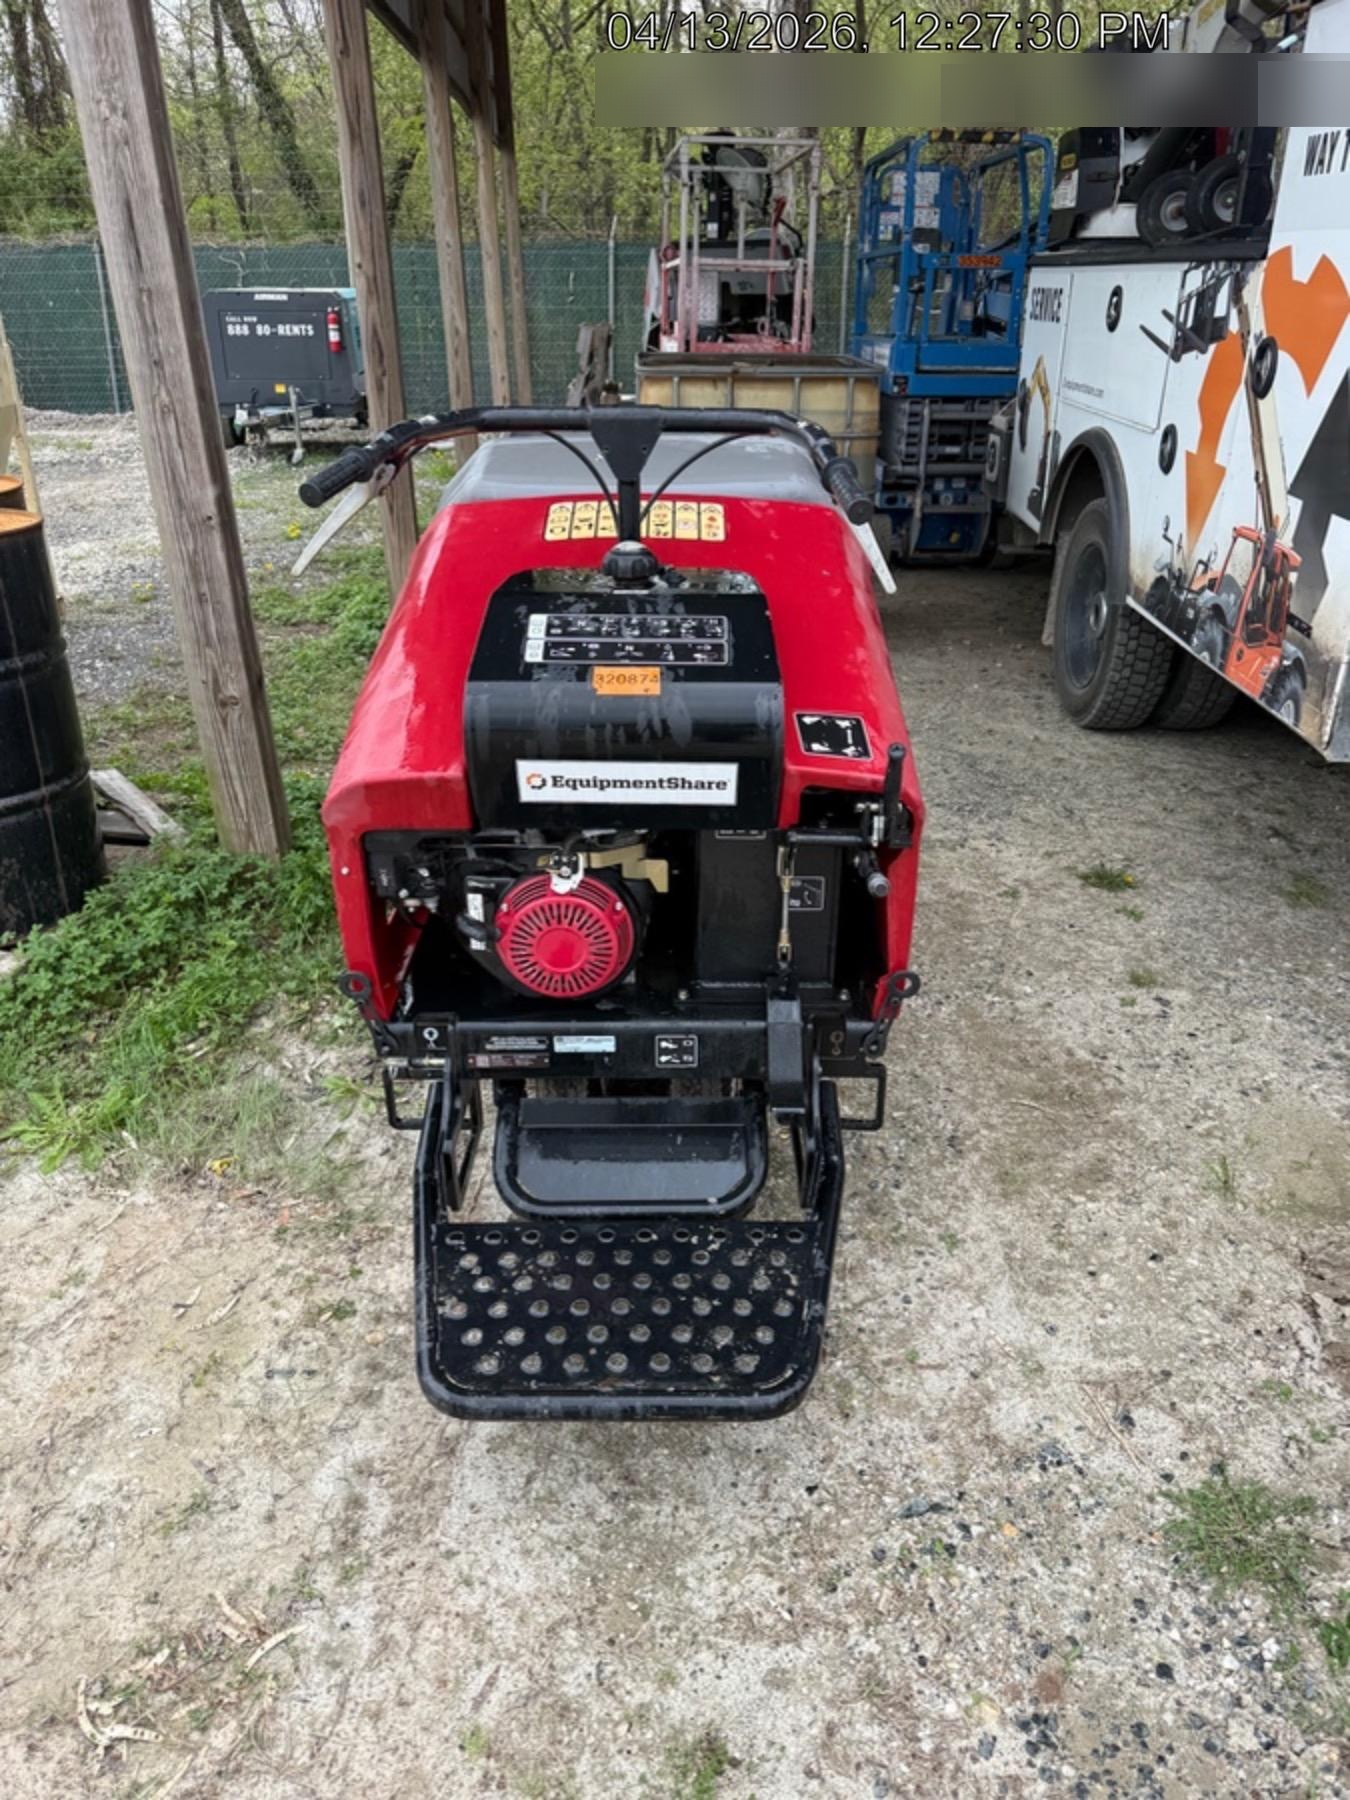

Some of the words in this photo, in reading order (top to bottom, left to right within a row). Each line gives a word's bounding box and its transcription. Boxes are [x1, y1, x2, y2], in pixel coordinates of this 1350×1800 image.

[1303, 130, 1341, 176] WAY
[1030, 287, 1063, 323] SERVICE
[227, 324, 249, 336] 888
[256, 324, 314, 336] 80-RENTS
[551, 775, 728, 791] EquipmentShare
